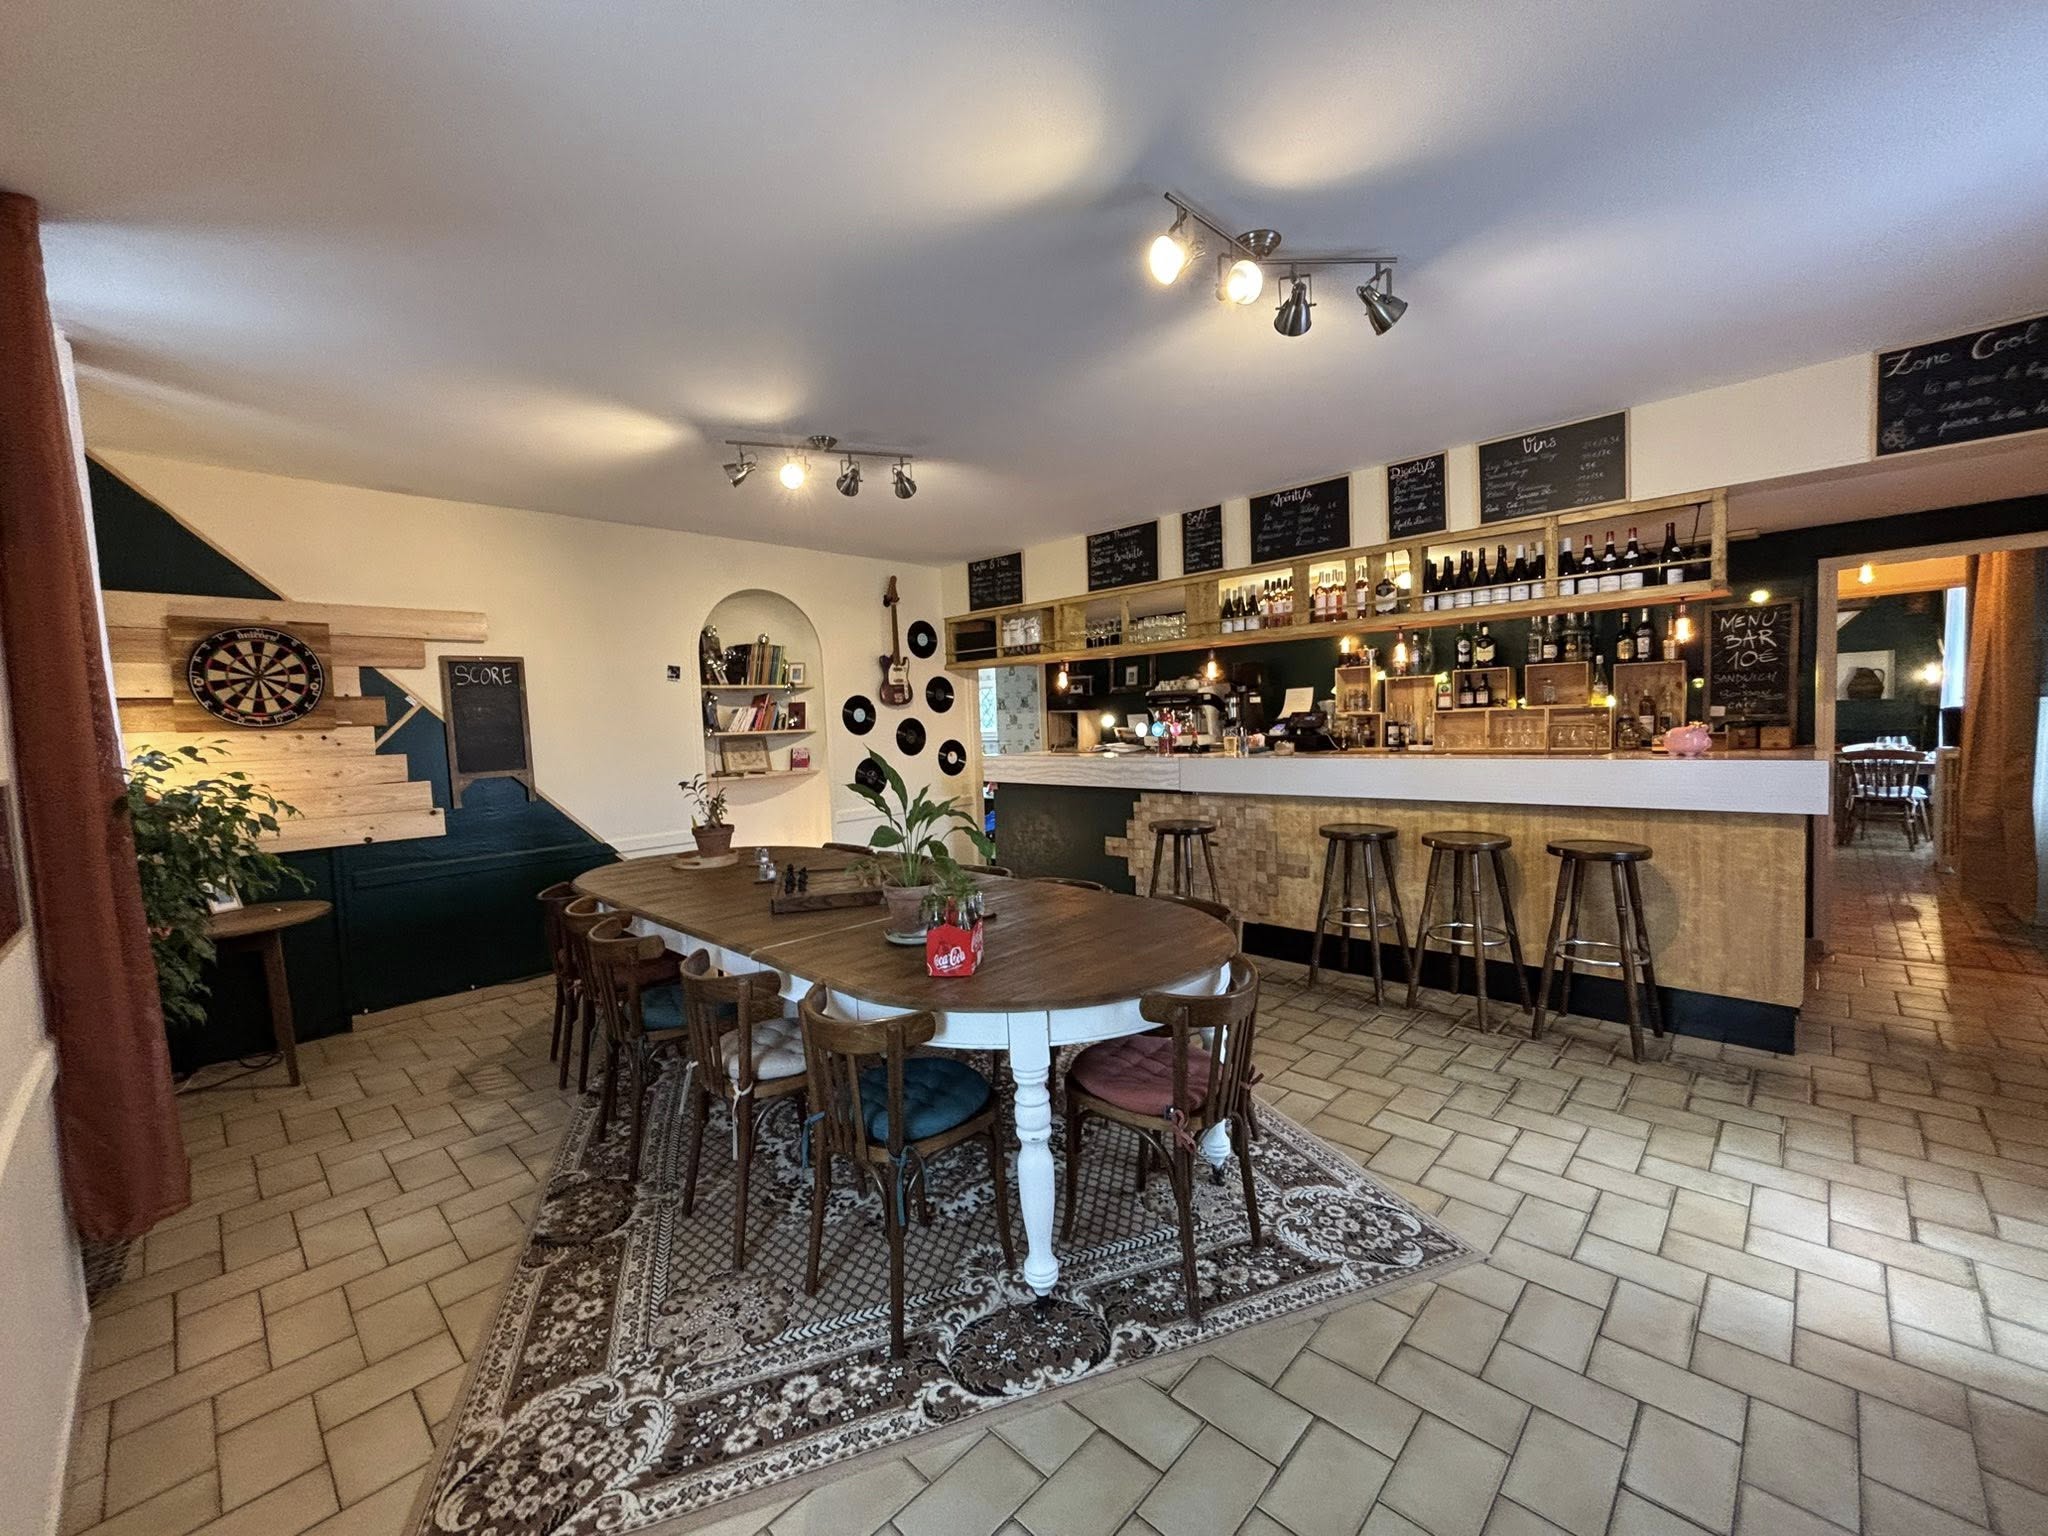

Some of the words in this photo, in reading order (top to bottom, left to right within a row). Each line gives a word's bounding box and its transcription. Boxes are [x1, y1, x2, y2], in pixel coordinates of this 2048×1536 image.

[1884, 351, 1952, 378] Zone
[1522, 436, 1557, 454] Vins
[1720, 611, 1778, 633] MENU
[1723, 629, 1777, 650] BAR
[454, 665, 513, 686] SCORE
